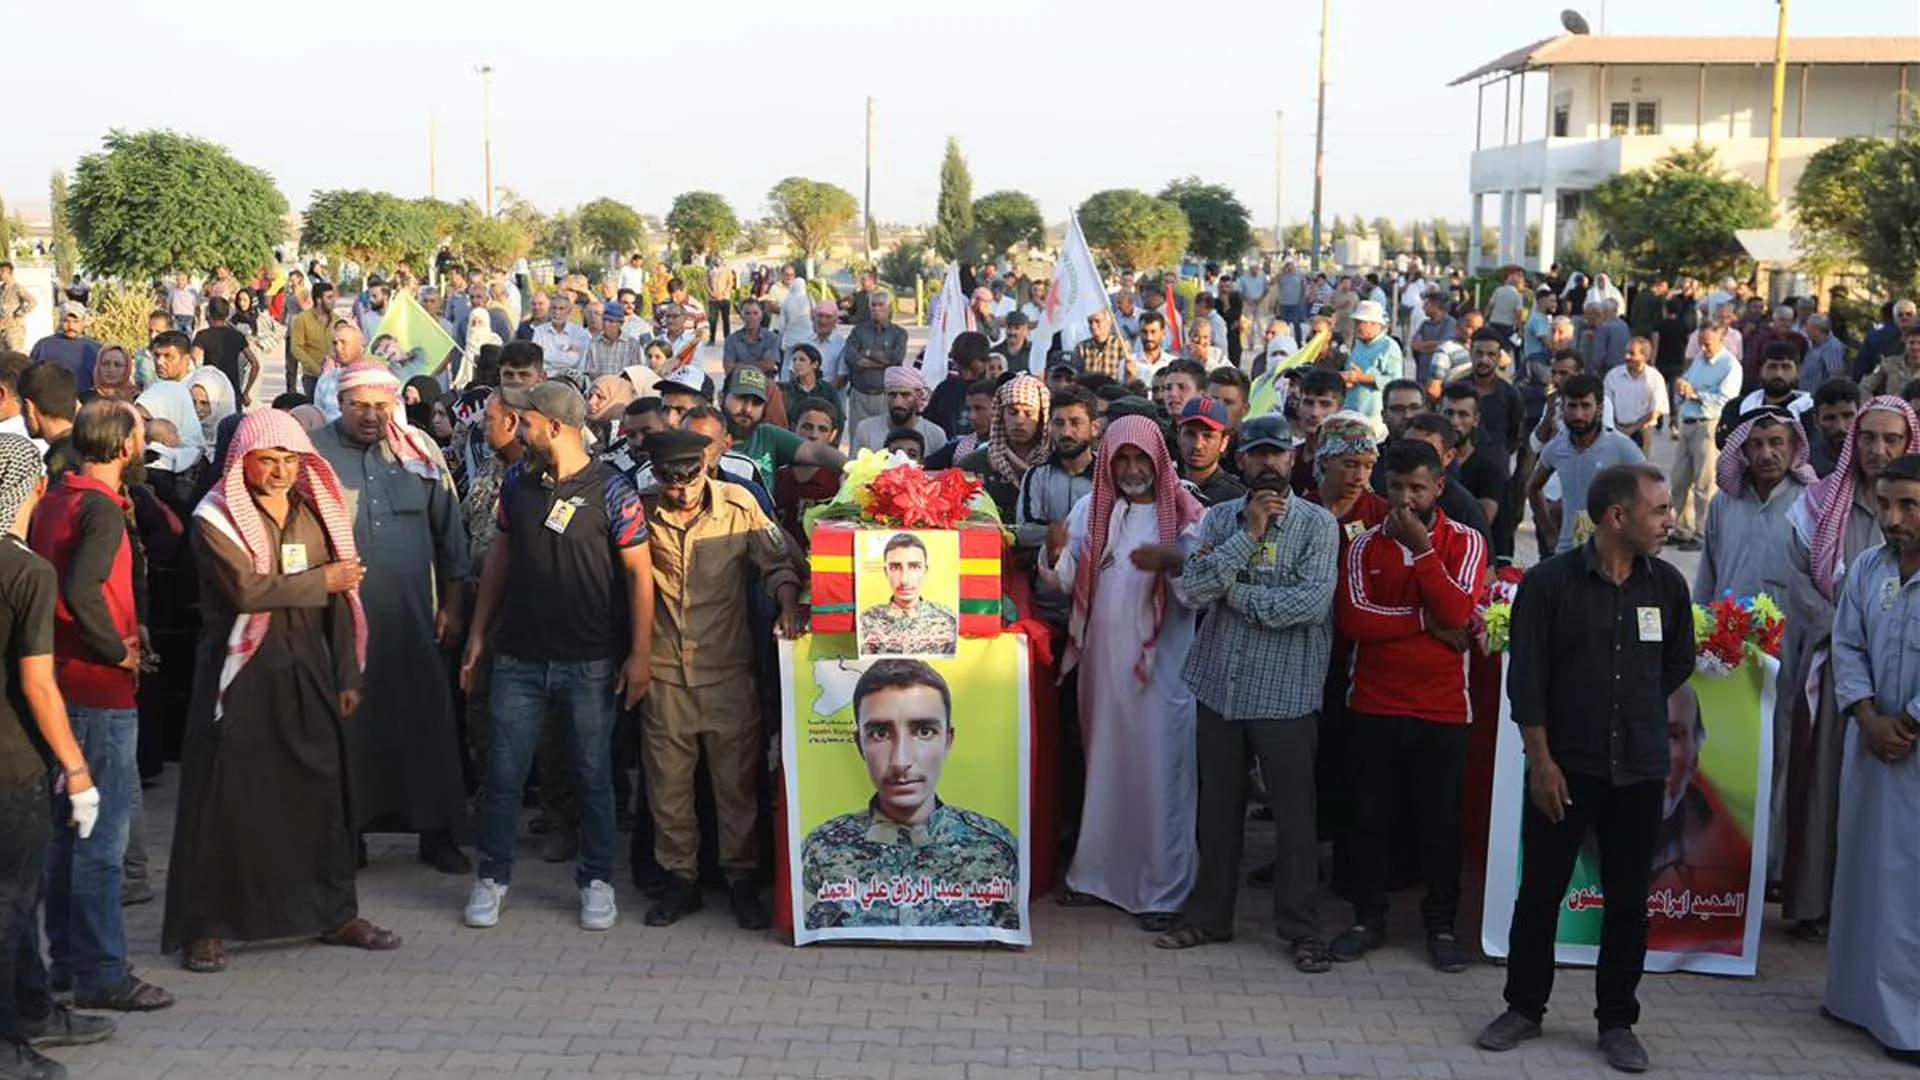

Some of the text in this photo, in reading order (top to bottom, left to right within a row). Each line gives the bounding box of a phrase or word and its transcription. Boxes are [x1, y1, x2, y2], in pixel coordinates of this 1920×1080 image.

[817, 875, 1012, 910] الشهيد عبد الرزاق علي الحمد
[1647, 888, 1690, 920] ابراهي
[1691, 891, 1746, 920] الشهيد
